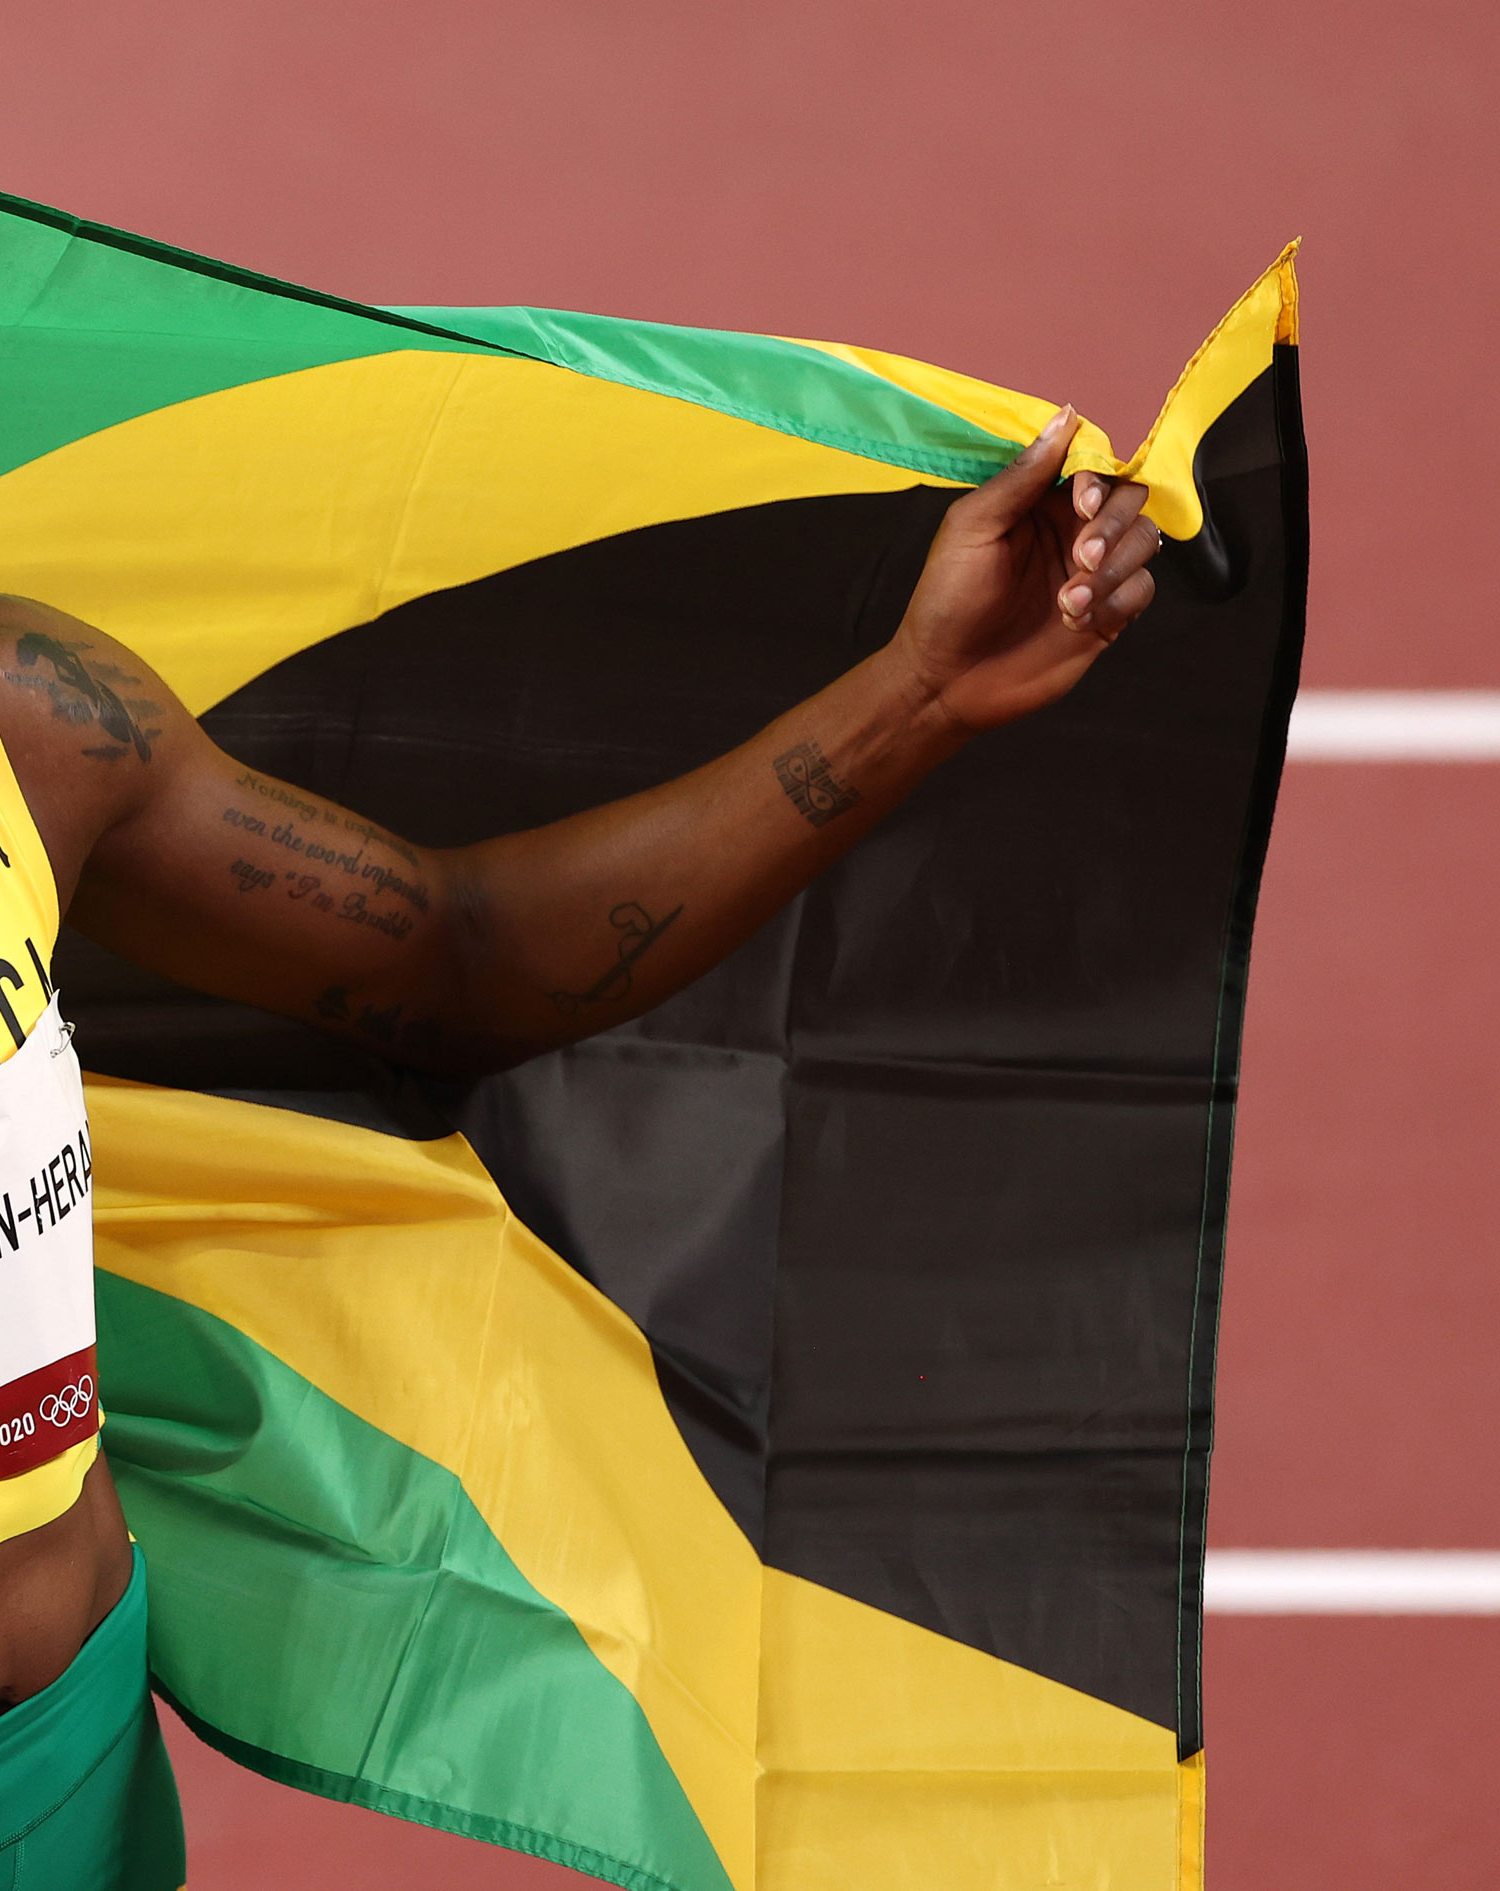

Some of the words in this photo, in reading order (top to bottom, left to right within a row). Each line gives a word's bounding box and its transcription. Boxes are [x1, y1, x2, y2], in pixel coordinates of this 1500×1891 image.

[235, 771, 318, 822] Nothing
[221, 807, 268, 837] even
[270, 823, 303, 853] the
[305, 849, 360, 876] word
[230, 859, 277, 892] says
